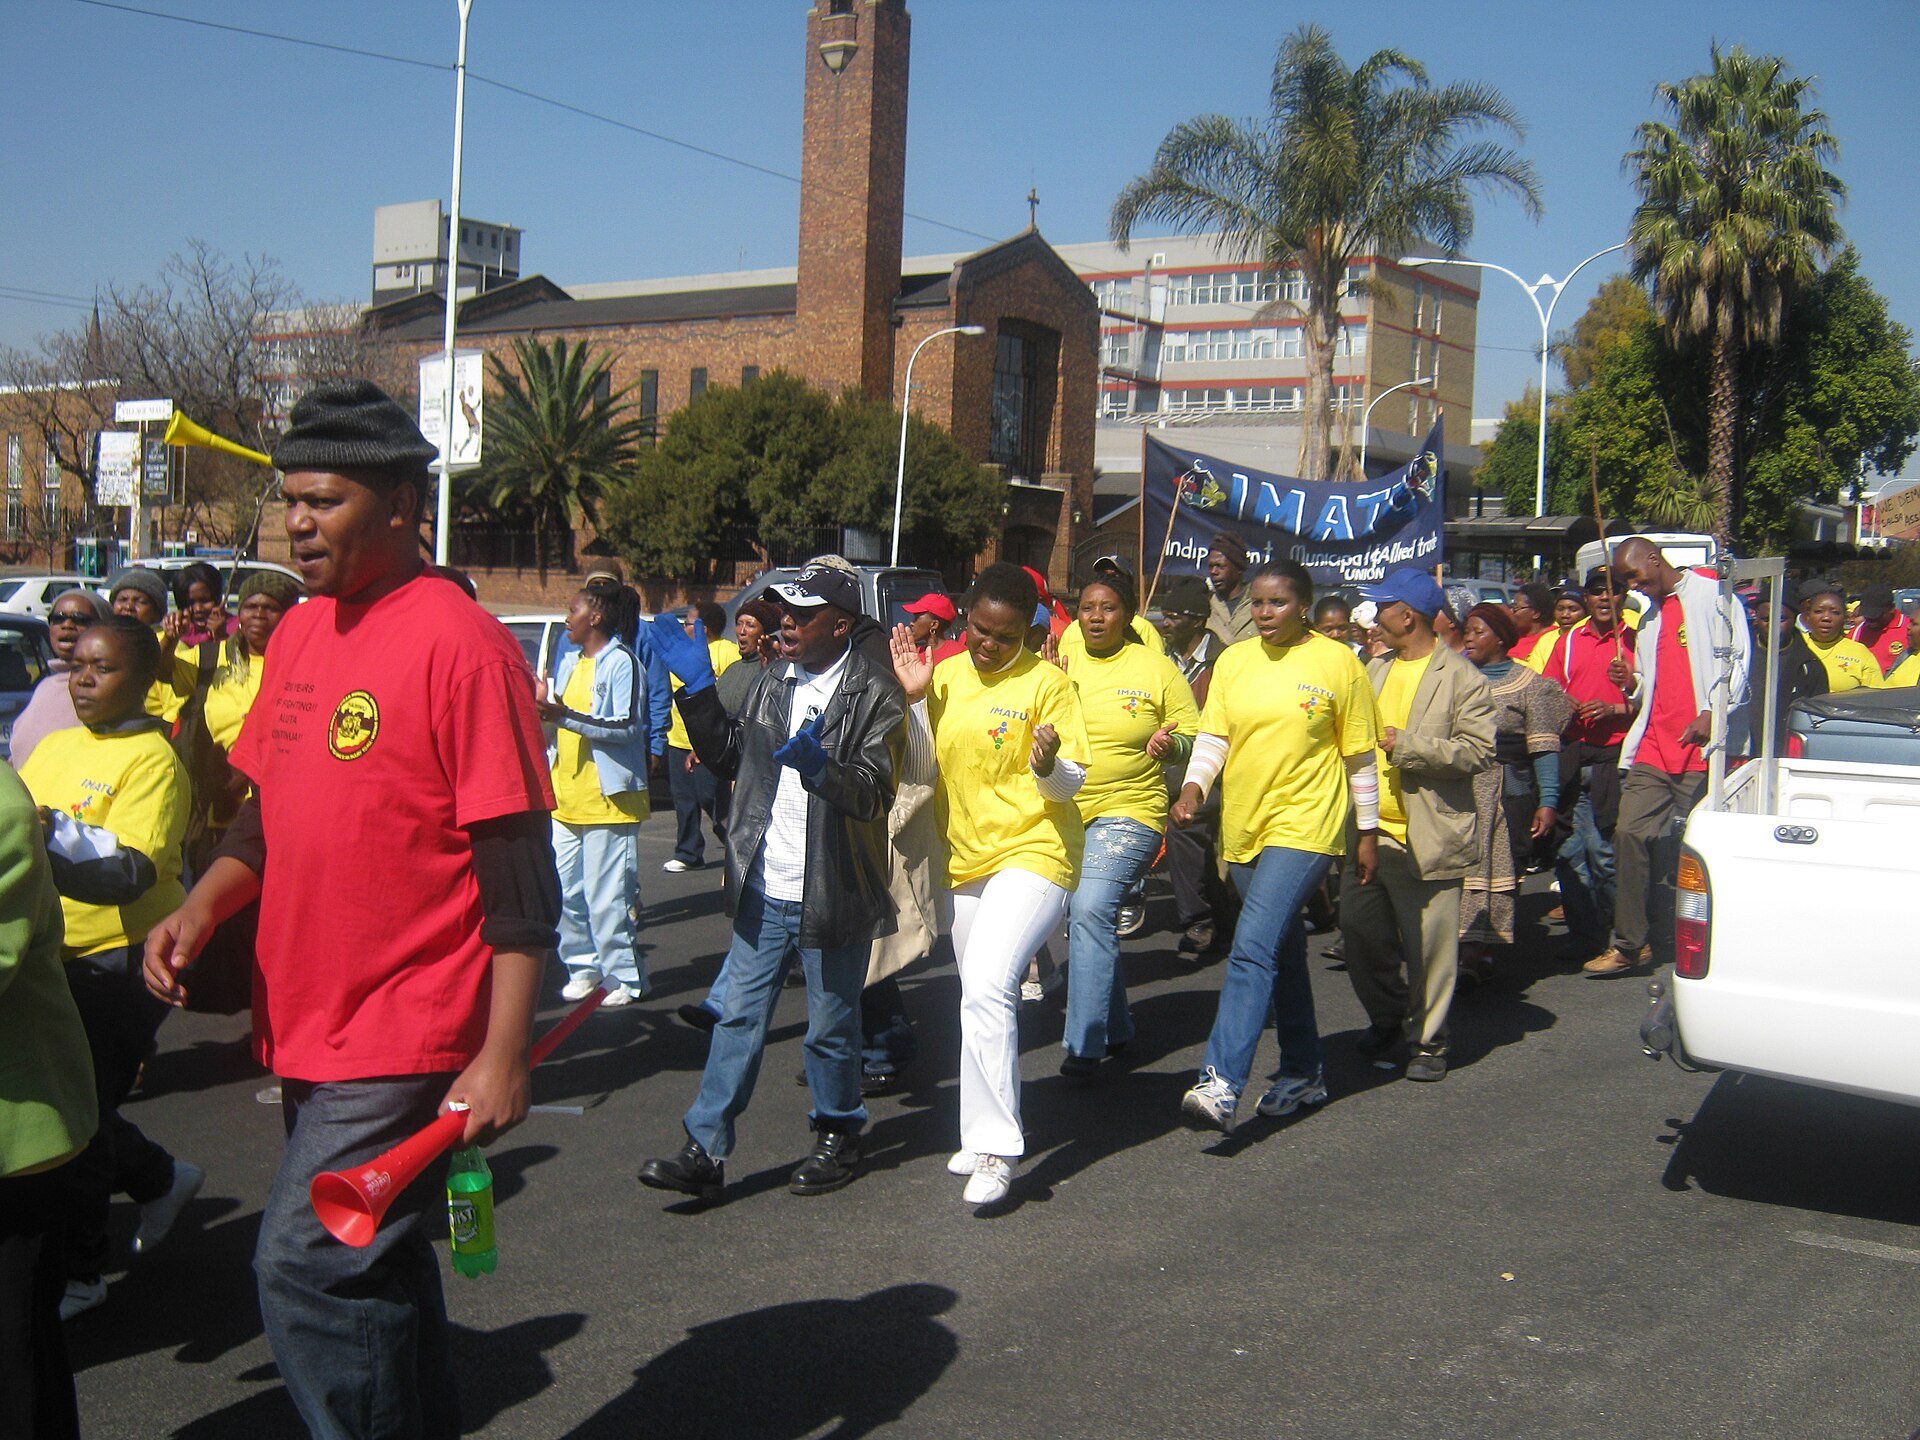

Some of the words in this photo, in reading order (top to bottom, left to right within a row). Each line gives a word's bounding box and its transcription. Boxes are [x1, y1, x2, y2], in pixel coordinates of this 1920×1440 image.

[1876, 498, 1894, 514] WE
[1904, 513, 1920, 527] ASS
[1344, 566, 1385, 581] UNION
[1117, 689, 1152, 699] IMATU
[1297, 683, 1335, 699] IMATU
[989, 706, 1028, 721] IMATU
